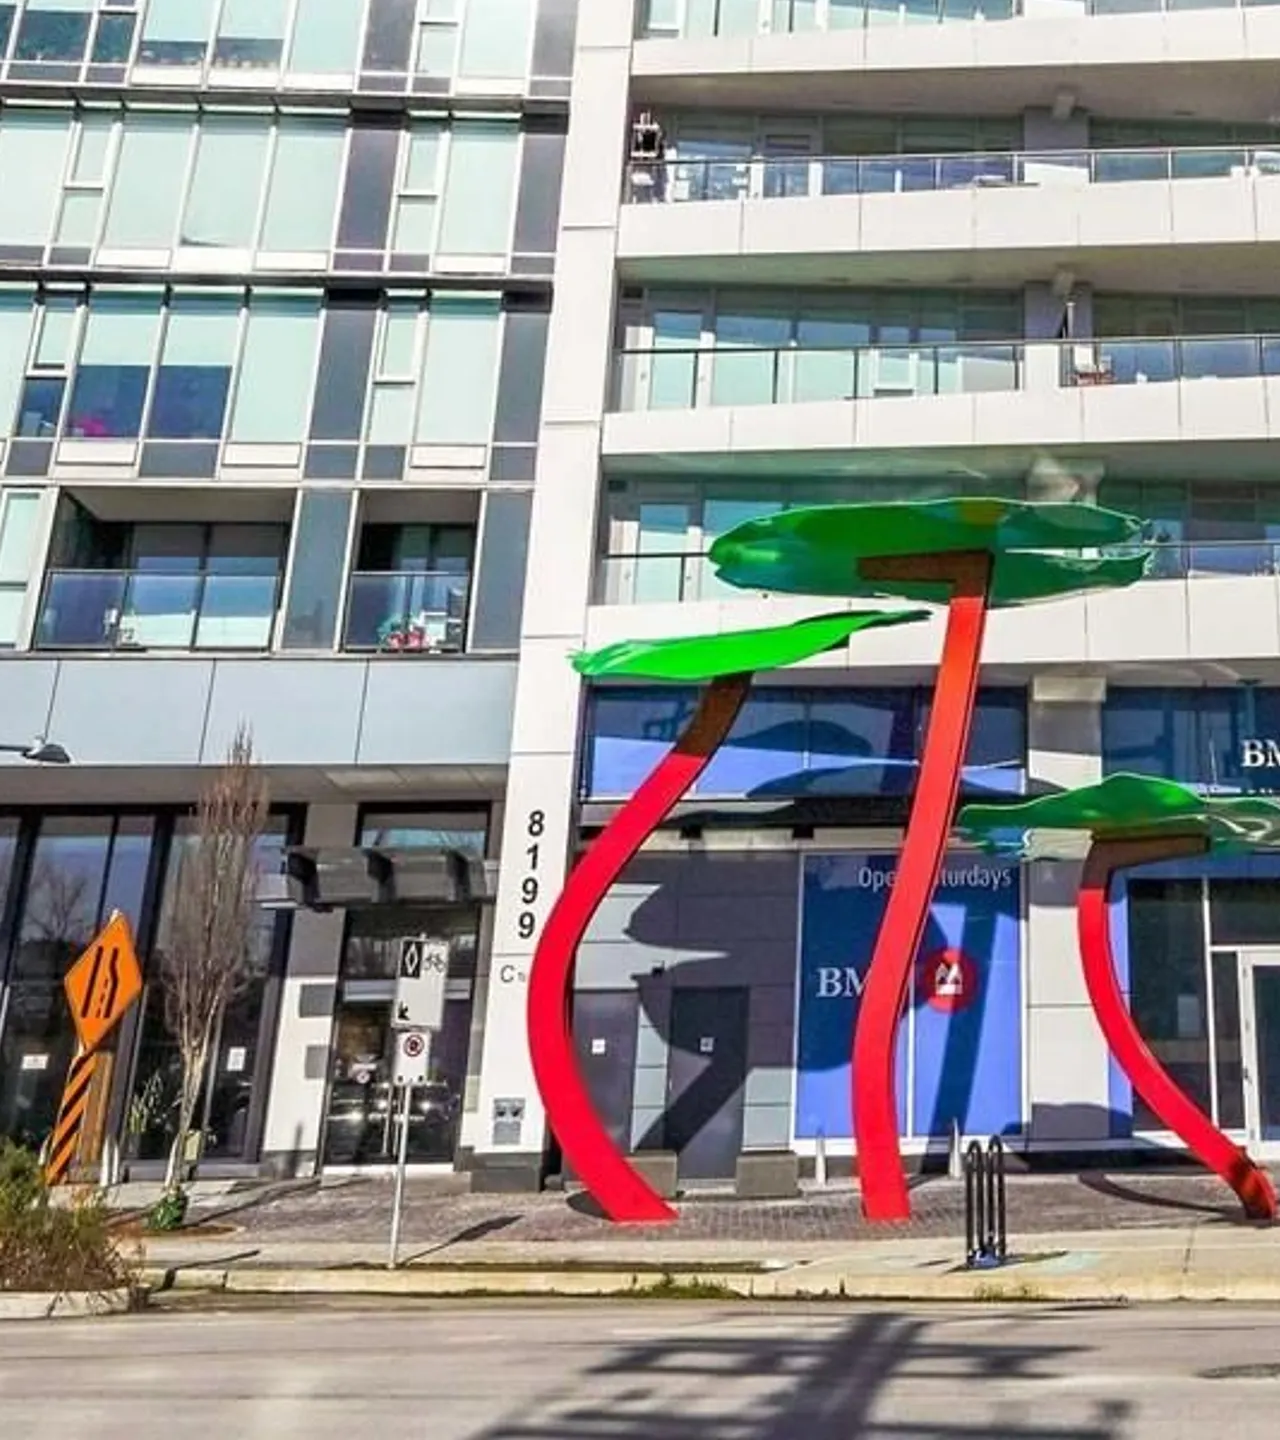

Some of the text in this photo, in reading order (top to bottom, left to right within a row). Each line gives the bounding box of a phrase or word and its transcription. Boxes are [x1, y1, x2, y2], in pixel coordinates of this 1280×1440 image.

[517, 809, 546, 940] 8199
[857, 864, 1013, 893] Ope turdays
[815, 966, 867, 998] BM
